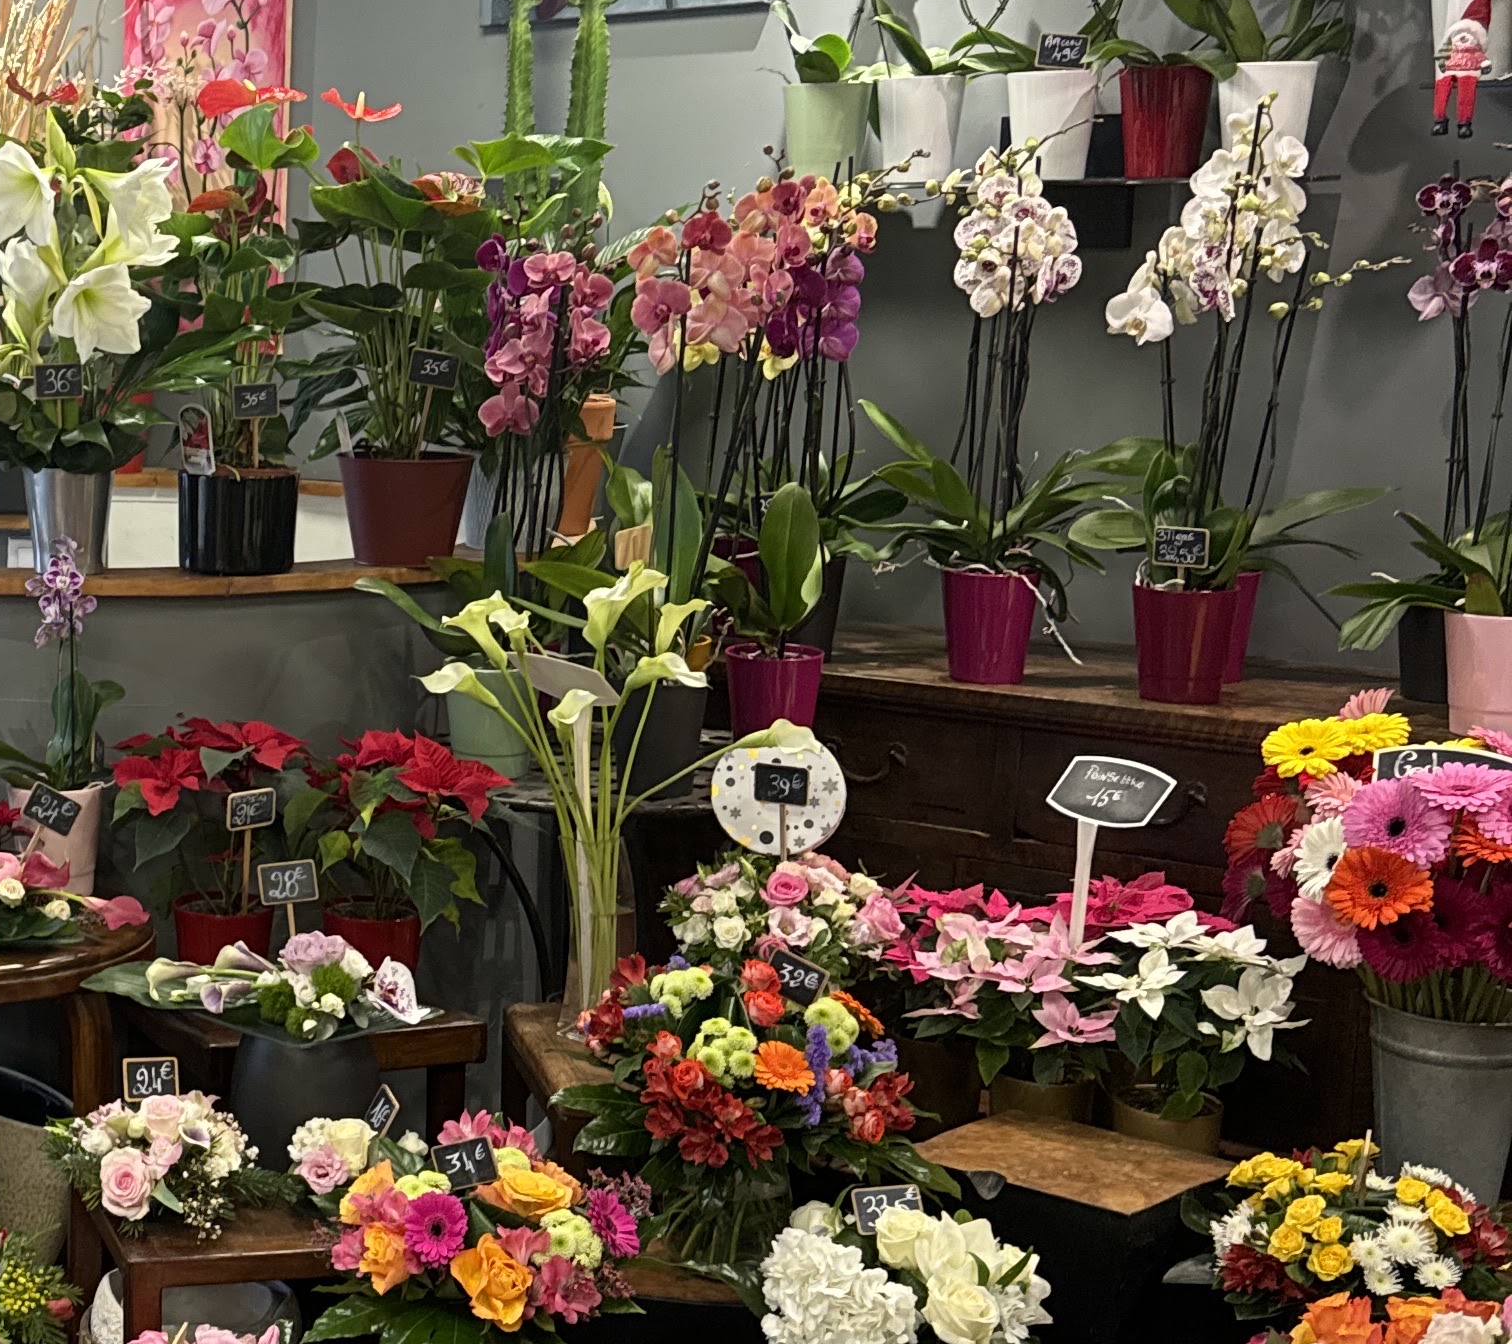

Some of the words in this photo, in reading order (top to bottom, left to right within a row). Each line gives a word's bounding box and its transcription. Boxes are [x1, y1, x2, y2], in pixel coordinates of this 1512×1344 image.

[43, 368, 81, 395] 36€
[768, 773, 806, 799] 39€
[31, 794, 75, 824] 24€
[778, 962, 820, 990] 32€
[132, 1061, 174, 1095] 24€
[445, 1142, 486, 1175] 34€
